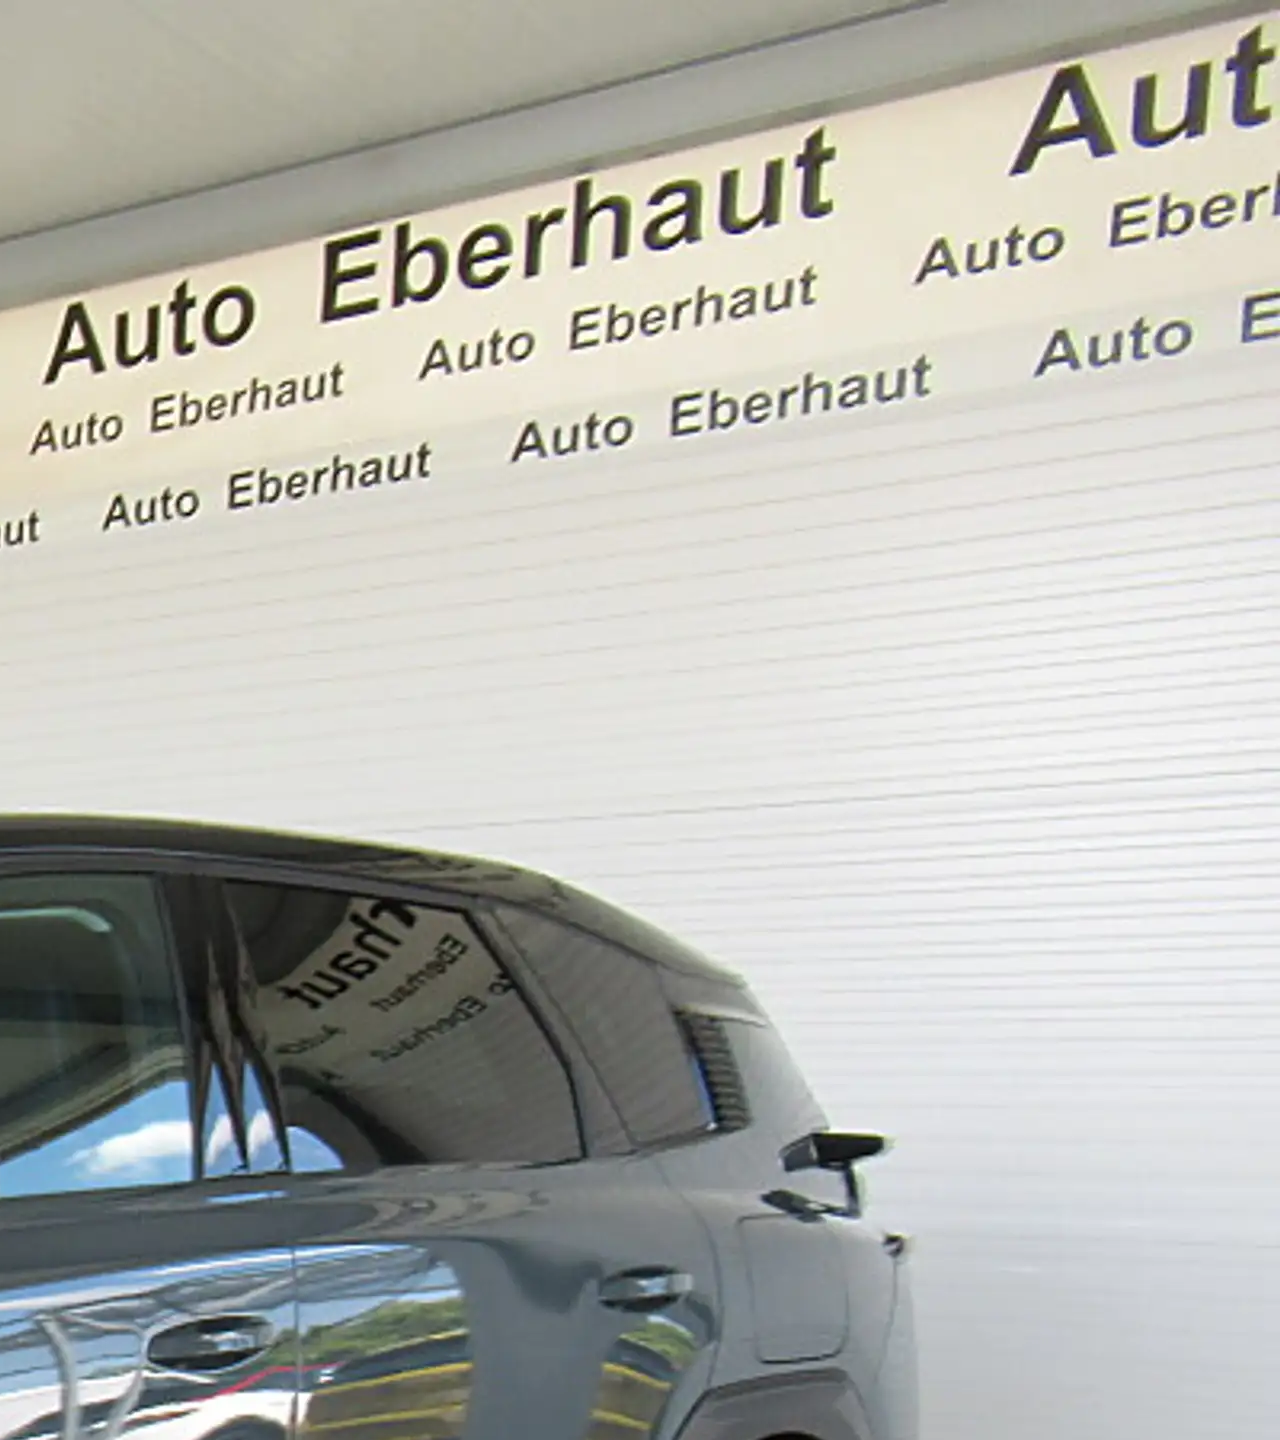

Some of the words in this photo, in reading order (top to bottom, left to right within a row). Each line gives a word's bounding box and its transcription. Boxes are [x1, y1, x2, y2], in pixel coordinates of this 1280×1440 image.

[43, 281, 255, 385] Auto
[320, 128, 836, 324] Eberhaut
[916, 227, 1064, 284] Auto
[419, 331, 535, 380] Auto
[569, 269, 817, 350] Eberhaut
[1035, 318, 1192, 376] Auto
[31, 415, 123, 455] Auto
[150, 364, 343, 433] Eberhaut
[512, 414, 633, 463] Auto
[672, 357, 931, 437] Eberhaut
[103, 489, 200, 531] Auto
[228, 444, 431, 510] Eberhaut
